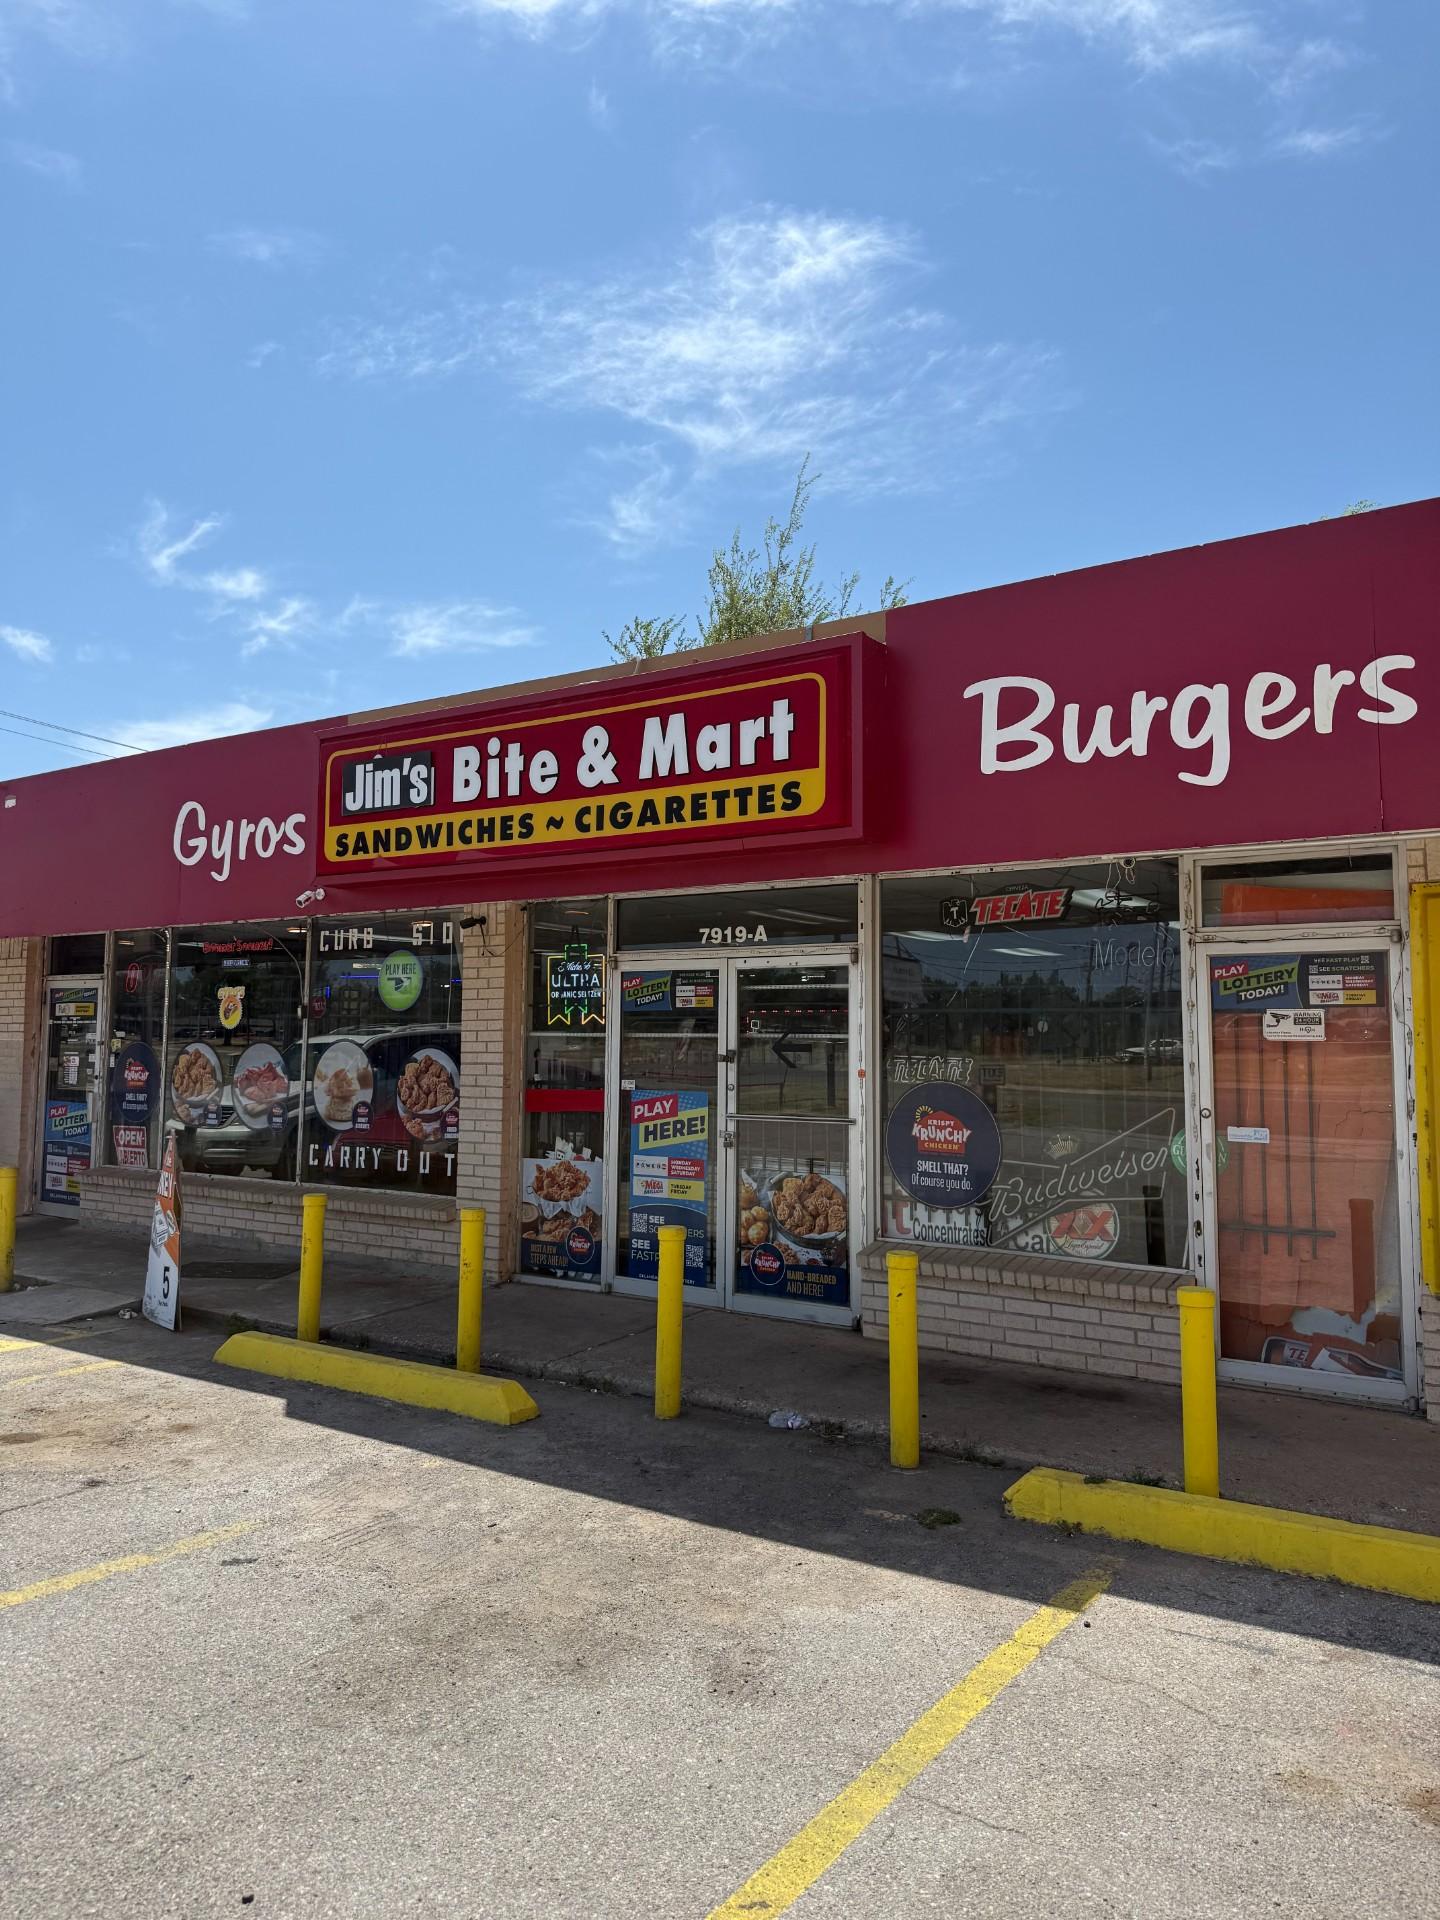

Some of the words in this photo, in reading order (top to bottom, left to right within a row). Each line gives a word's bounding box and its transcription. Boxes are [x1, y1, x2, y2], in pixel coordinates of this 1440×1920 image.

[963, 655, 1418, 786] Burgers
[345, 757, 428, 811] Jim's
[452, 737, 559, 803] Bite
[576, 725, 620, 788] &
[638, 699, 794, 780] Mart
[335, 812, 534, 857] SANDWICHES
[574, 781, 802, 833] CIGARETTES
[173, 801, 306, 882] Gyros
[970, 888, 1069, 925] TECATE
[319, 928, 374, 951] CURB
[698, 924, 768, 944] 7919-A
[1092, 937, 1175, 970] Modelo
[385, 964, 400, 975] PLAY
[401, 963, 417, 975] HERE
[1214, 963, 1245, 978] PLAY
[1223, 966, 1297, 991] LOTTERY
[551, 973, 600, 987] ULTRA
[623, 977, 641, 988] PLAY
[627, 980, 669, 998] LOTTERY
[636, 993, 663, 1006] TODAY!
[1239, 984, 1284, 1001] TODAY!
[50, 1106, 67, 1117] PLAY
[634, 1098, 674, 1119] PLAY
[643, 1115, 706, 1143] HERE!
[911, 1122, 973, 1143] KRUNCHY
[928, 1119, 955, 1127] KRISPY
[924, 1142, 960, 1150] CHICKEN
[308, 1143, 382, 1170] CARRY
[397, 1149, 456, 1177] OUT
[916, 1159, 942, 1174] SMELL
[942, 1161, 969, 1176] THAT?
[920, 1177, 945, 1188] course
[946, 1179, 960, 1192] you
[961, 1177, 973, 1191] do.
[989, 1147, 1168, 1222] Budweiser
[648, 1215, 665, 1225] SEE
[1050, 1209, 1117, 1241] XX
[648, 1225, 705, 1238] SCERS
[912, 1217, 986, 1247] Concentrates
[631, 1238, 651, 1250] SEE
[631, 1249, 655, 1261] FAST
[162, 1266, 170, 1299] 5
[786, 1281, 802, 1295] AND
[803, 1282, 824, 1297] HERE!
